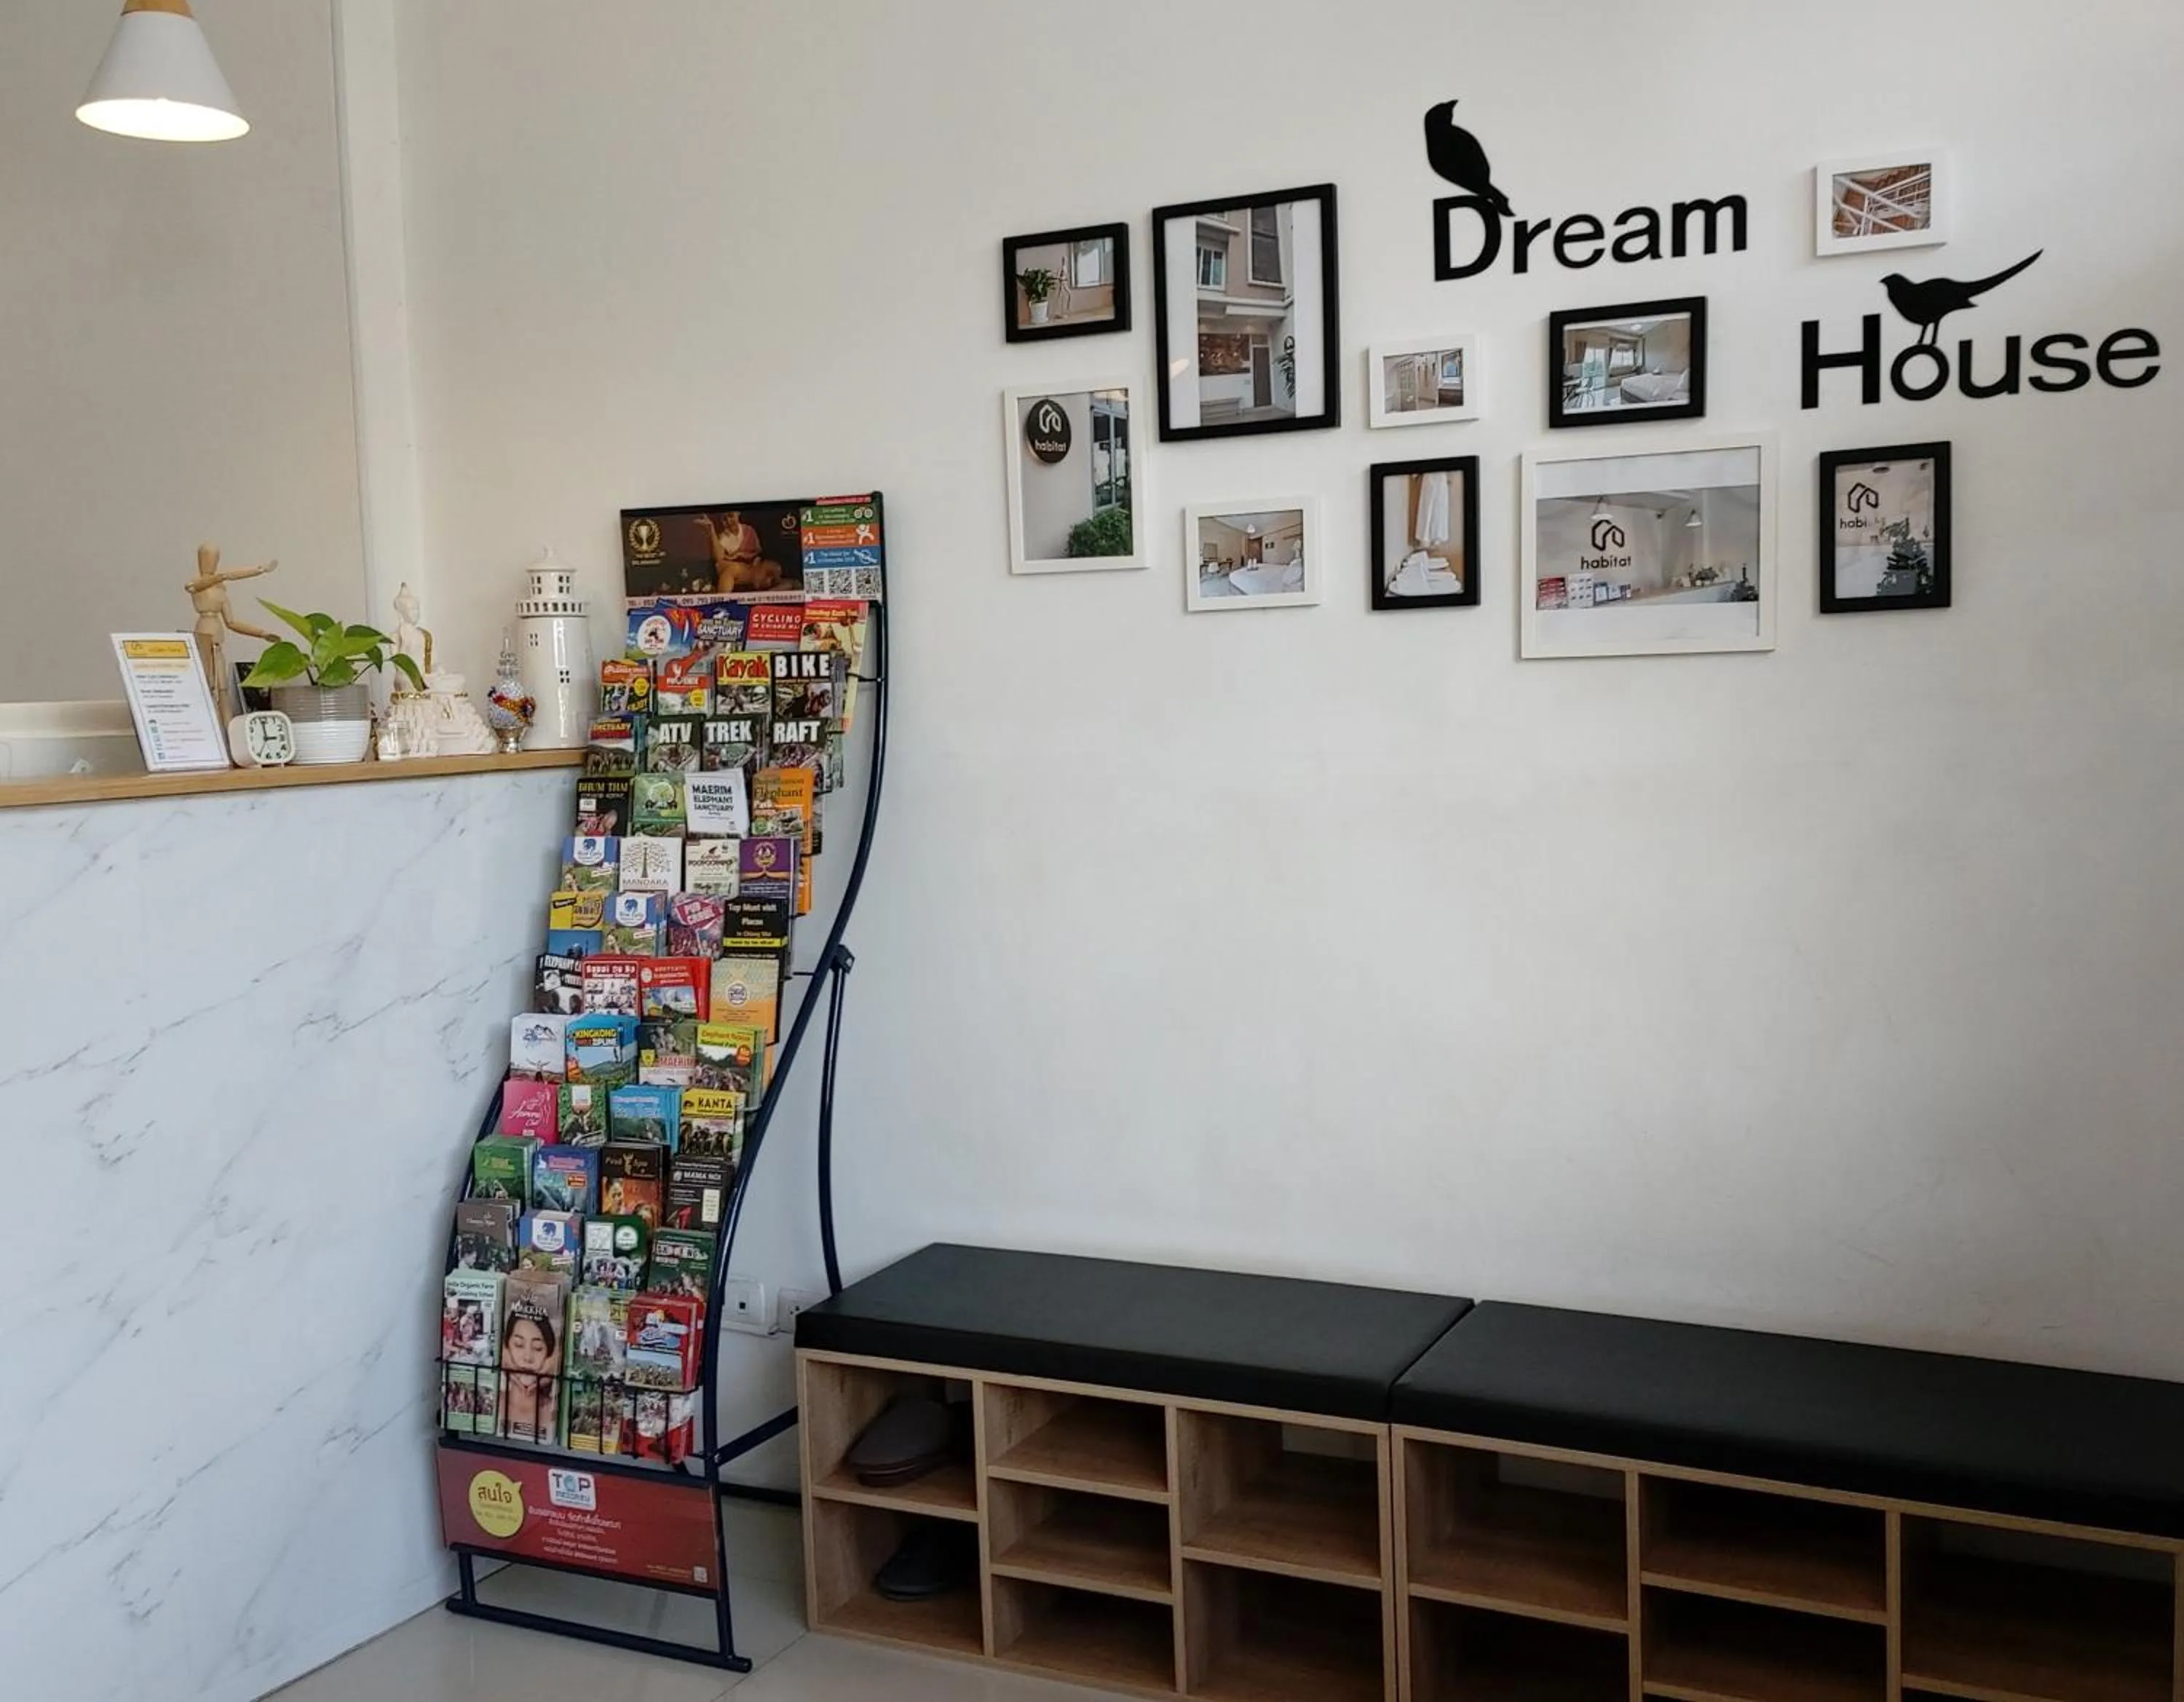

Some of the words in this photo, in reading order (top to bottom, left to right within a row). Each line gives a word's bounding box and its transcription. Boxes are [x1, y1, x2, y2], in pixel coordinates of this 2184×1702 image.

[1433, 194, 1747, 282] Dream
[1801, 313, 2161, 410] House
[1034, 439, 1067, 452] habitat
[1840, 516, 1867, 529] habi
[1580, 556, 1631, 570] habitat
[752, 613, 802, 623] CYCLING
[697, 624, 743, 636] SANCTUARY
[719, 655, 769, 678] Kayak
[775, 654, 830, 678] BIKE
[659, 722, 692, 743] ATV
[705, 720, 752, 743] TREK
[773, 721, 820, 743] RAFT
[692, 784, 732, 795] MAERIM
[693, 795, 733, 804] ELEPHANT
[694, 804, 735, 812] SANCTUARY
[698, 1096, 733, 1108] KANTA
[478, 1481, 513, 1503] สนใจ
